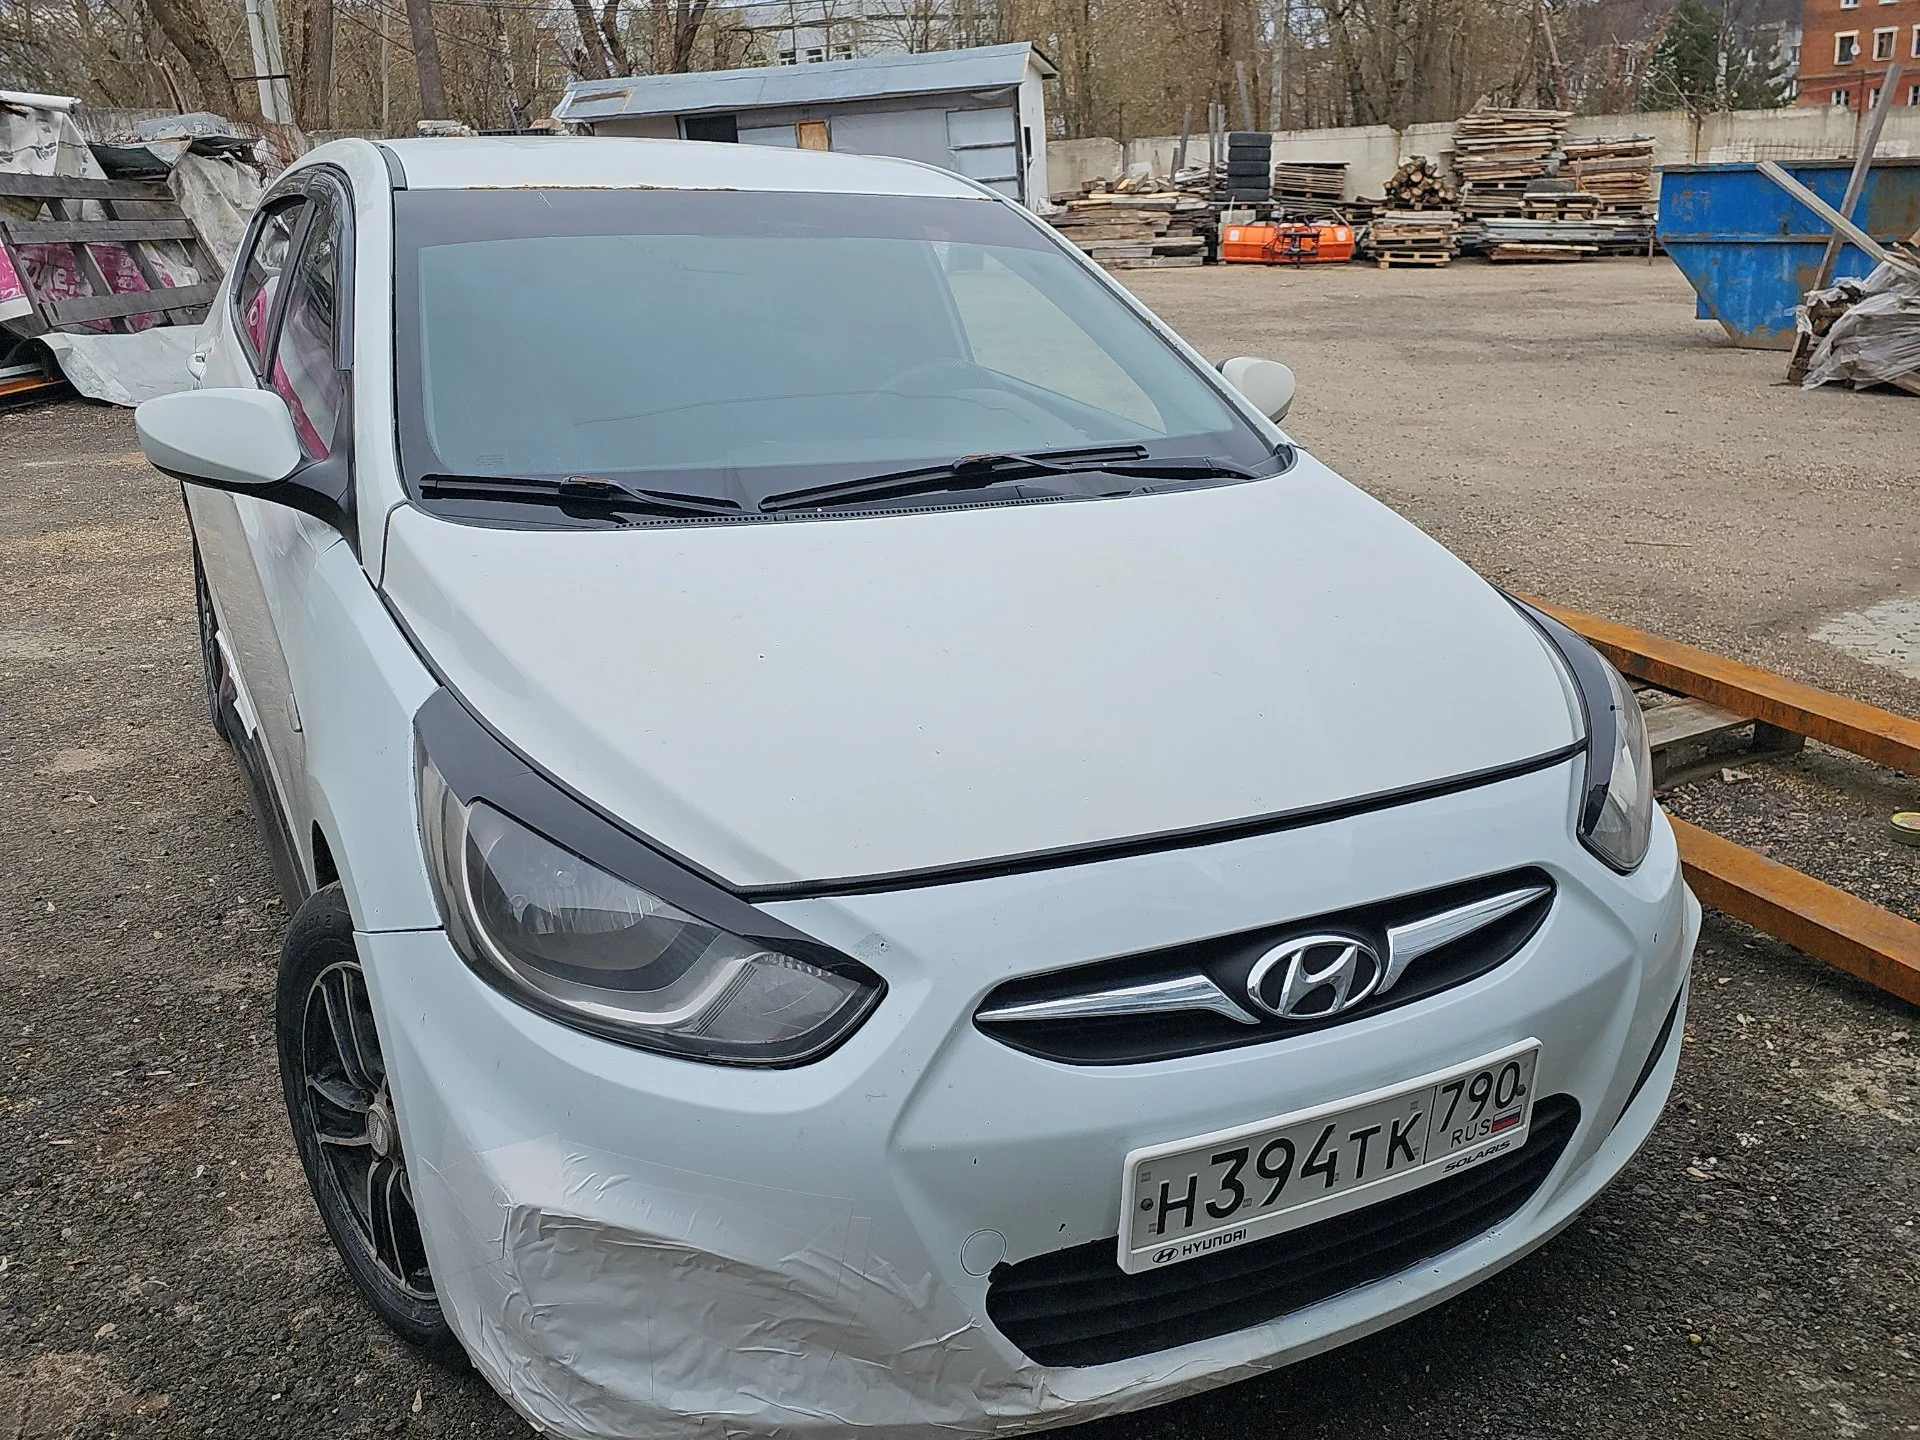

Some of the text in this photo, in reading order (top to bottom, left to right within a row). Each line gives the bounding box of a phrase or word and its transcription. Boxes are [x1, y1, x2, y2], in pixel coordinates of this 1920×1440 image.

[1157, 1061, 1521, 1235] Н394ТК 790
[1451, 1119, 1491, 1148] RUS
[1442, 1140, 1511, 1173] SOLARIS
[1182, 1229, 1247, 1256] HYUNDAI
